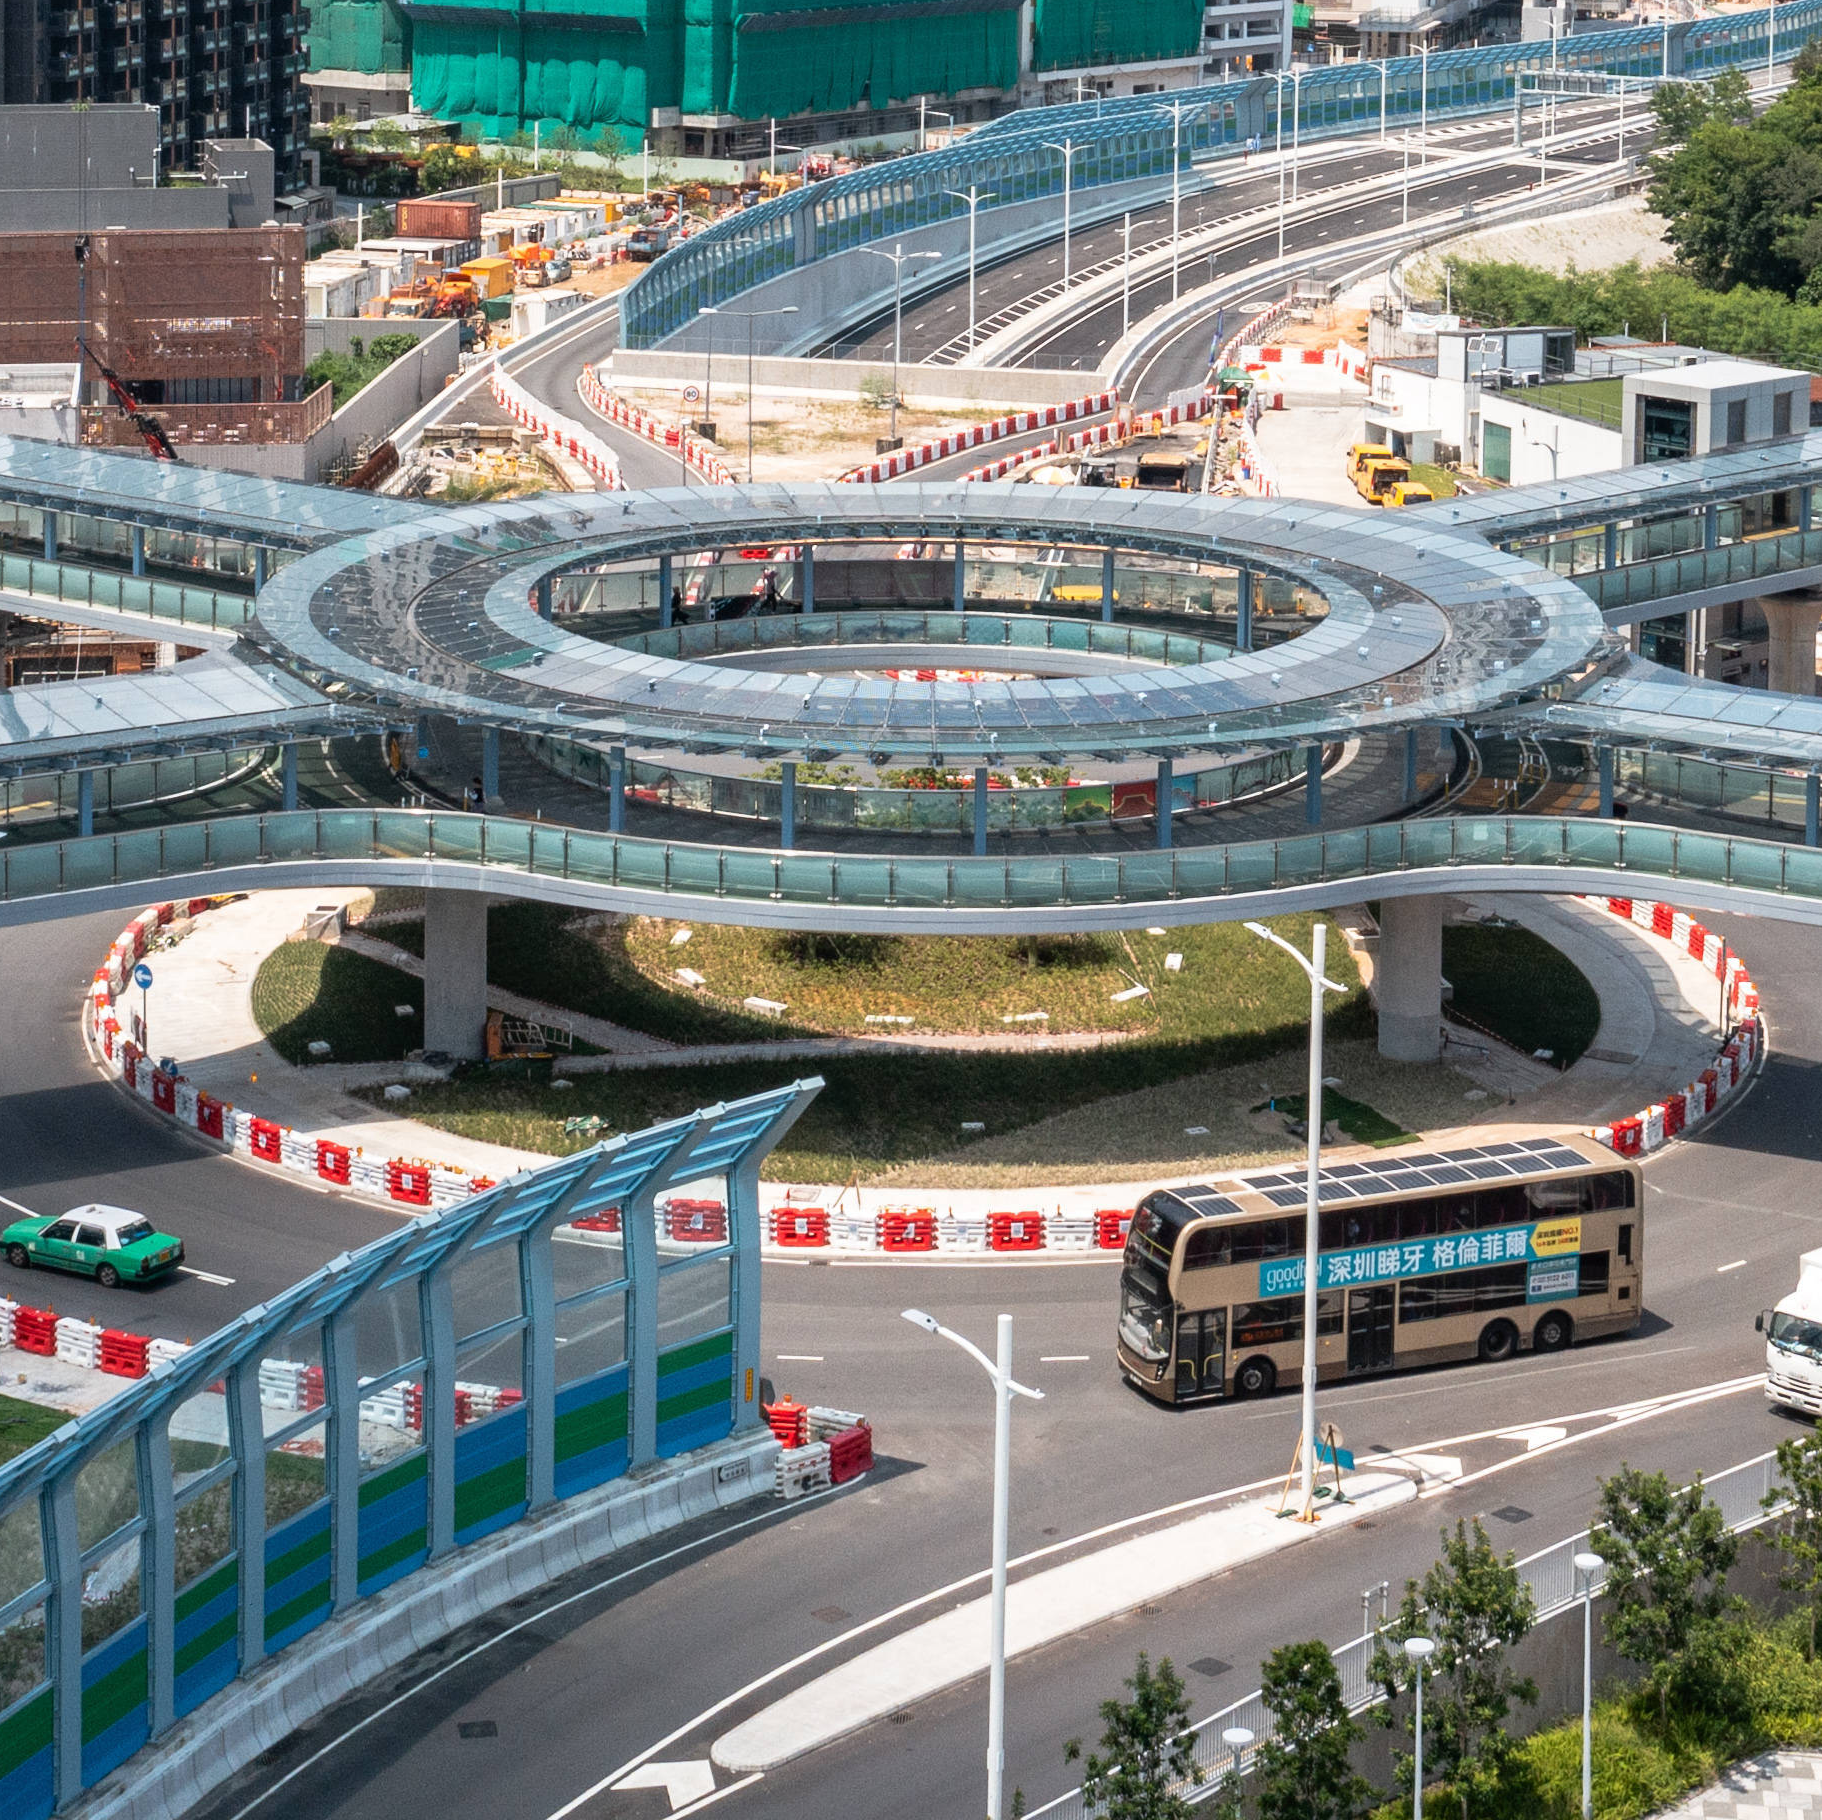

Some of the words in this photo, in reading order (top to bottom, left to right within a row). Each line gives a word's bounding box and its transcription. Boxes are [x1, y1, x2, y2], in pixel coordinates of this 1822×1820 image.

[1266, 1257, 1323, 1292] goodfl
[1327, 1244, 1426, 1284] 深圳睇牙
[1431, 1230, 1528, 1269] 格倫菲爾
